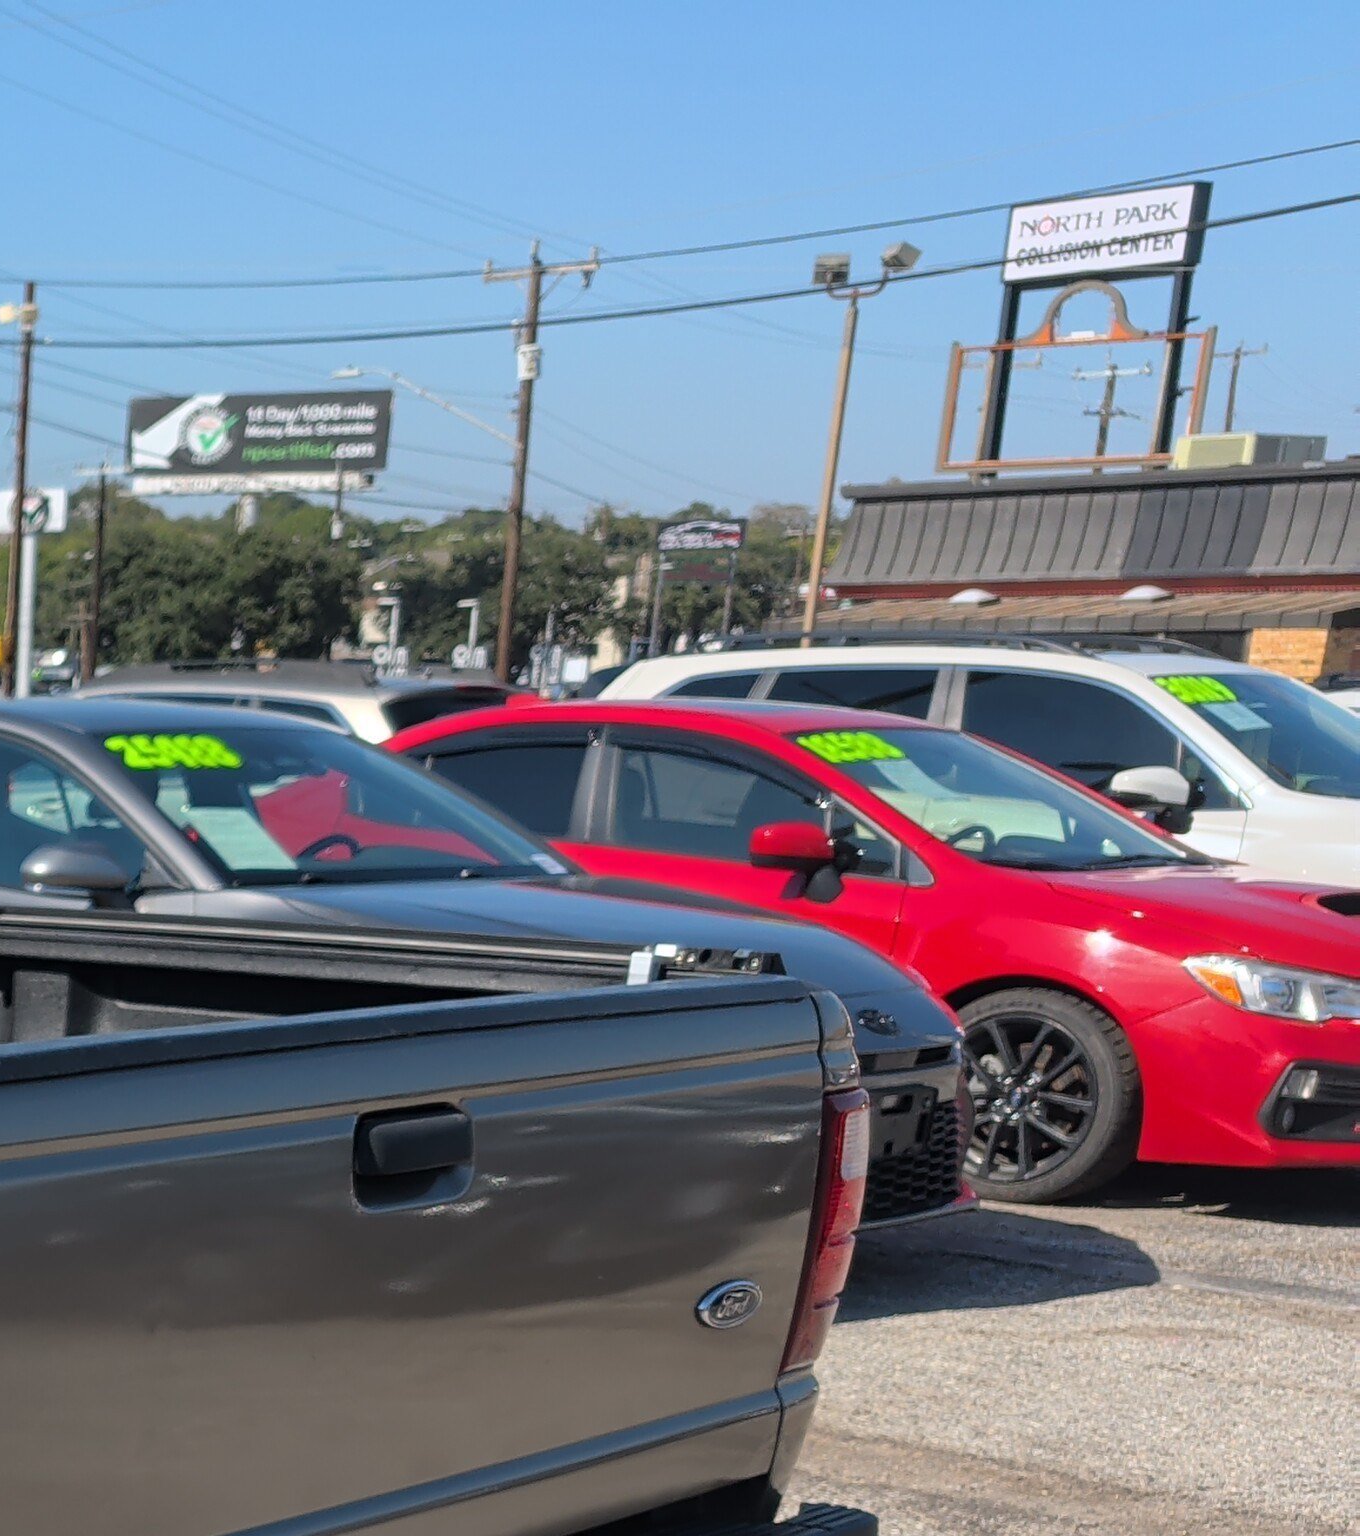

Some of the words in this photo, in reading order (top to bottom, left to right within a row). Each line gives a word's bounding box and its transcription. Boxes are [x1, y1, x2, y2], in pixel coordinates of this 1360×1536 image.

[1018, 210, 1104, 238] NORTH
[1114, 201, 1180, 227] PARK
[1016, 238, 1103, 266] COLLISION
[1108, 233, 1176, 256] CENTER
